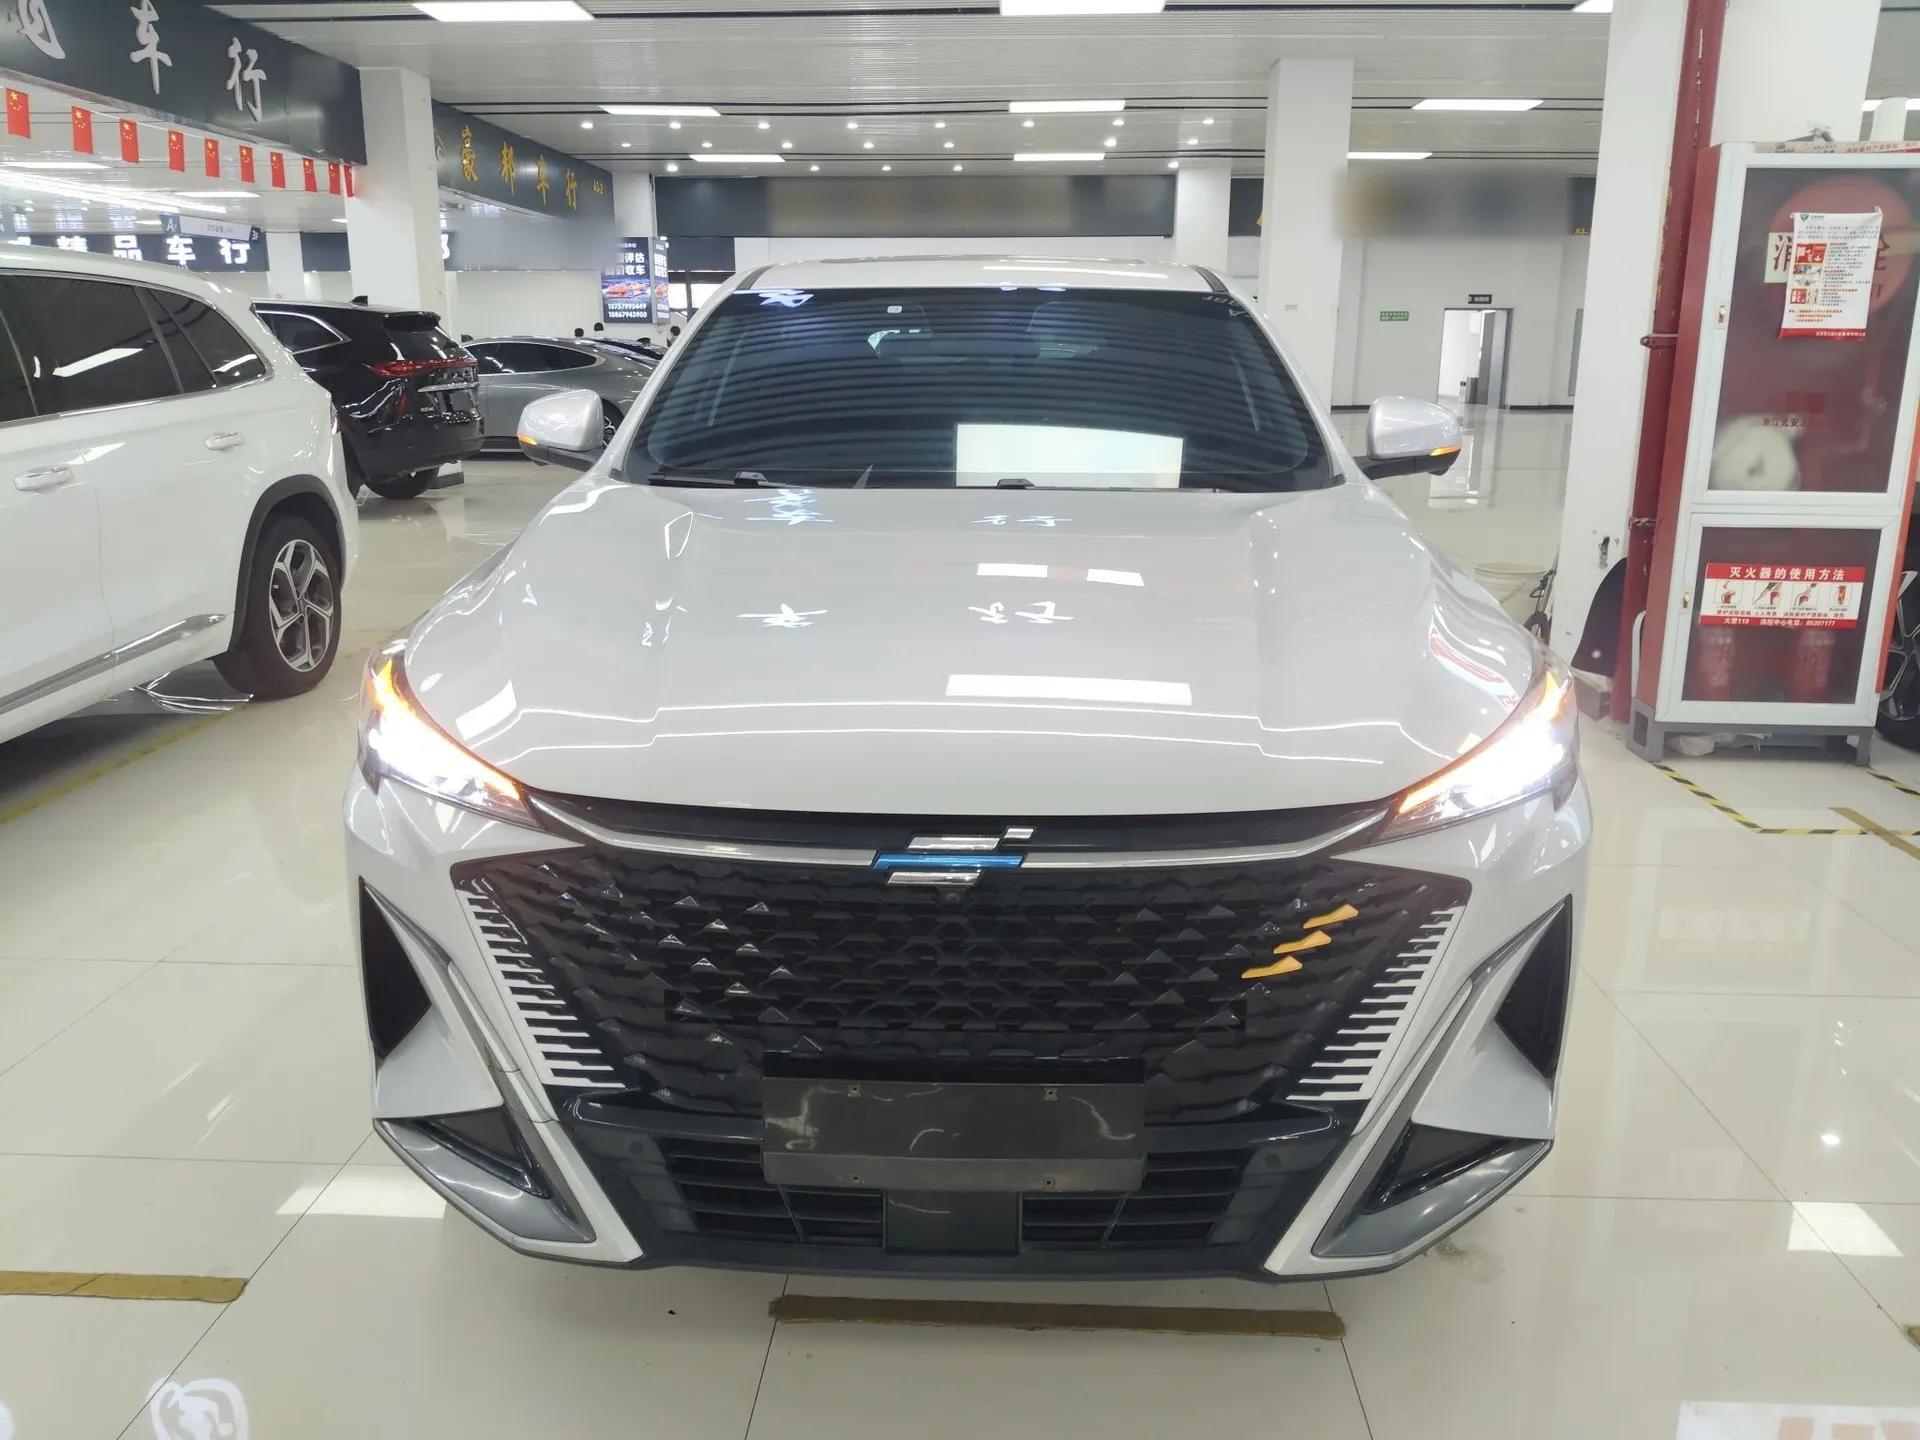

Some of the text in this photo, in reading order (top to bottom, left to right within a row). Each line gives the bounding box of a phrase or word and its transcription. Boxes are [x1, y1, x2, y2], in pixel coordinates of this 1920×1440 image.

[1729, 567, 1846, 581] 灭火器的使用方法
